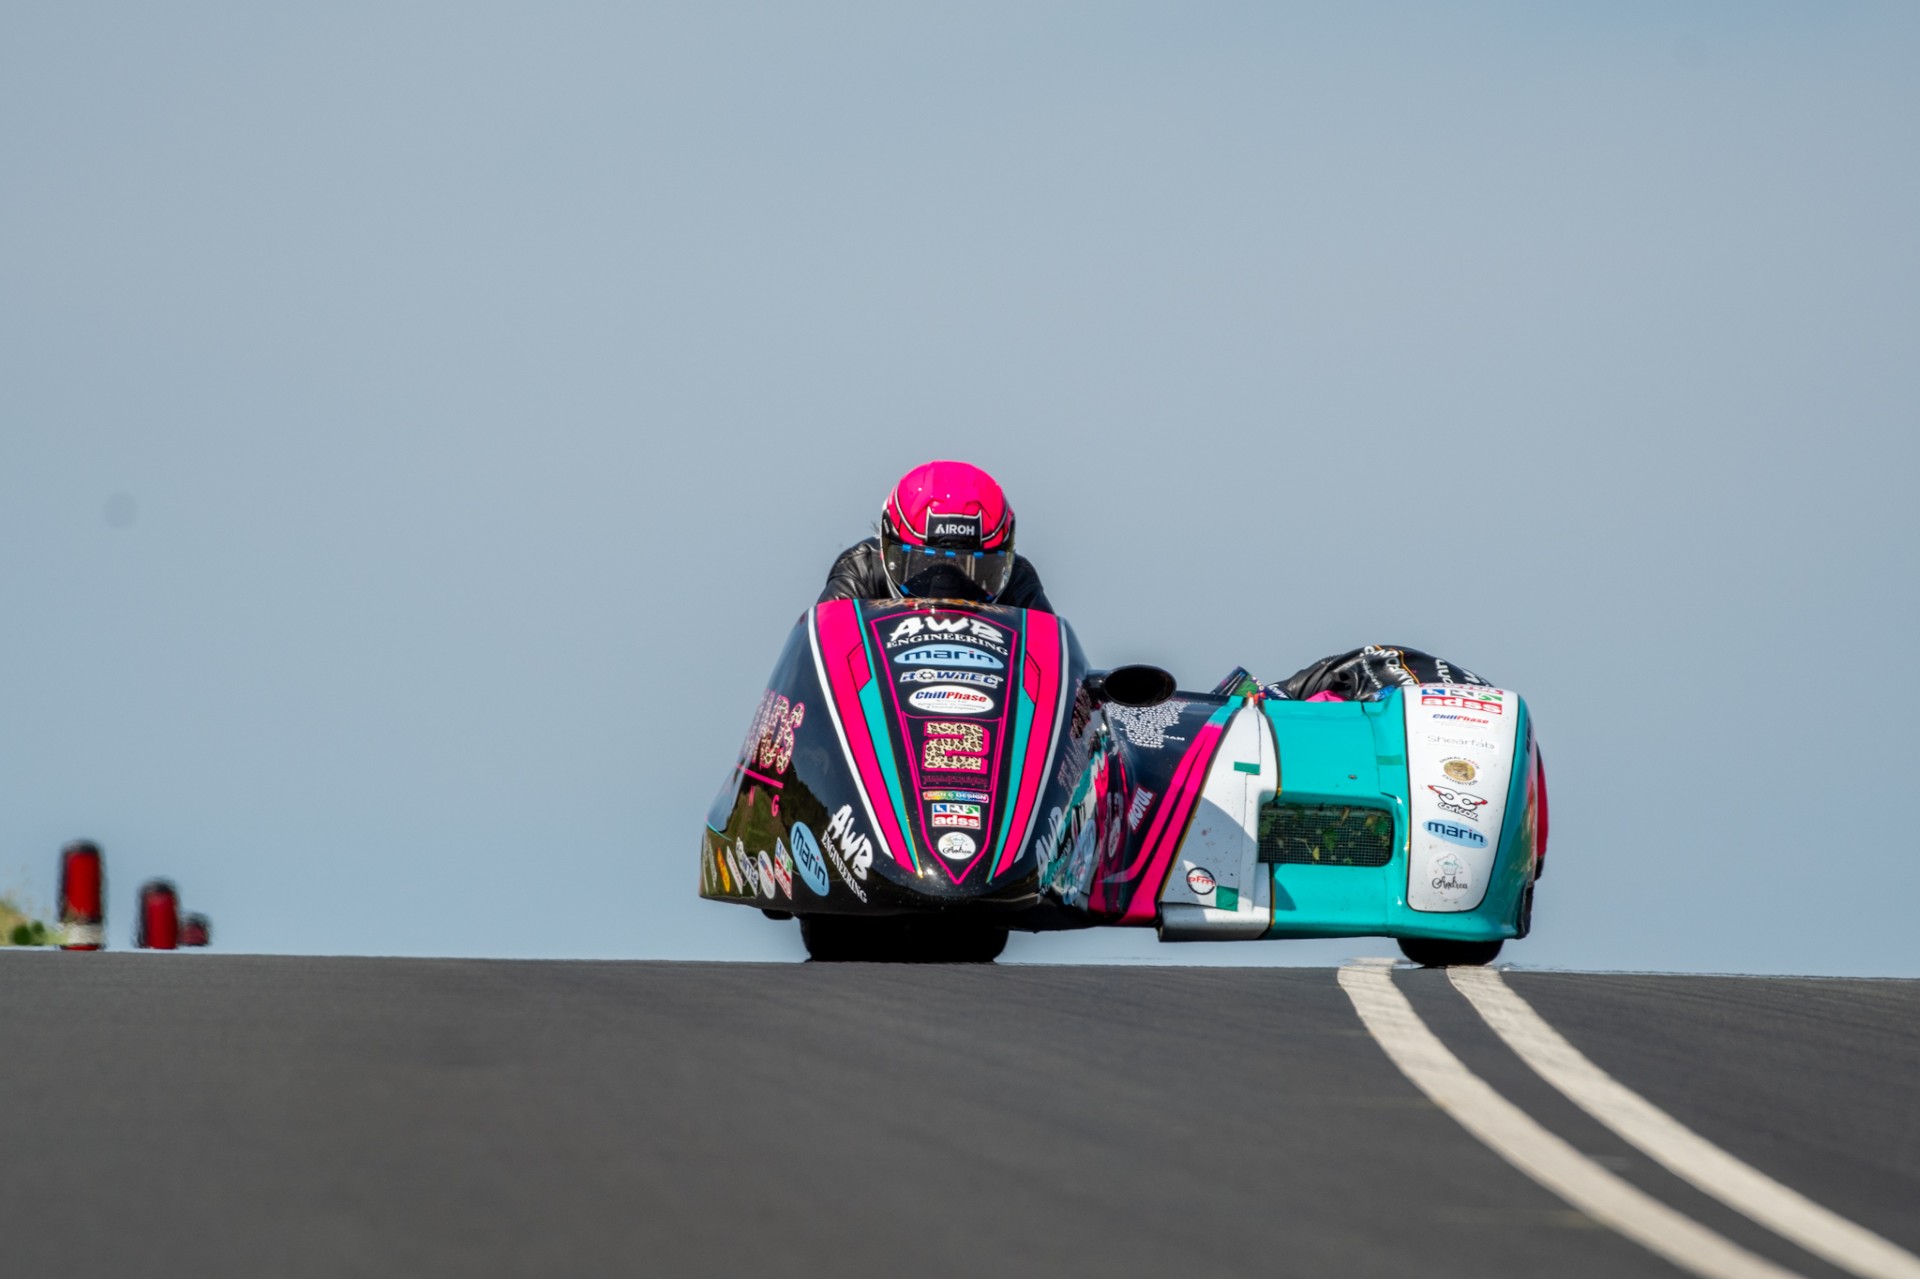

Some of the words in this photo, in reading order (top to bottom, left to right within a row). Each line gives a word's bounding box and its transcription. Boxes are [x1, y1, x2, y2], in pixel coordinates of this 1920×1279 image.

[935, 523, 975, 535] AIROH
[890, 616, 1005, 644] AWB
[886, 632, 1009, 656] ENGINEERING
[904, 649, 994, 663] marin
[915, 690, 987, 703] ChillPhase
[1422, 697, 1502, 714] adss
[922, 722, 990, 774] 2
[1129, 787, 1153, 830] MOTUL
[934, 815, 979, 828] adss
[1427, 821, 1484, 843] marin
[827, 804, 873, 880] AWB
[793, 826, 825, 886] marin
